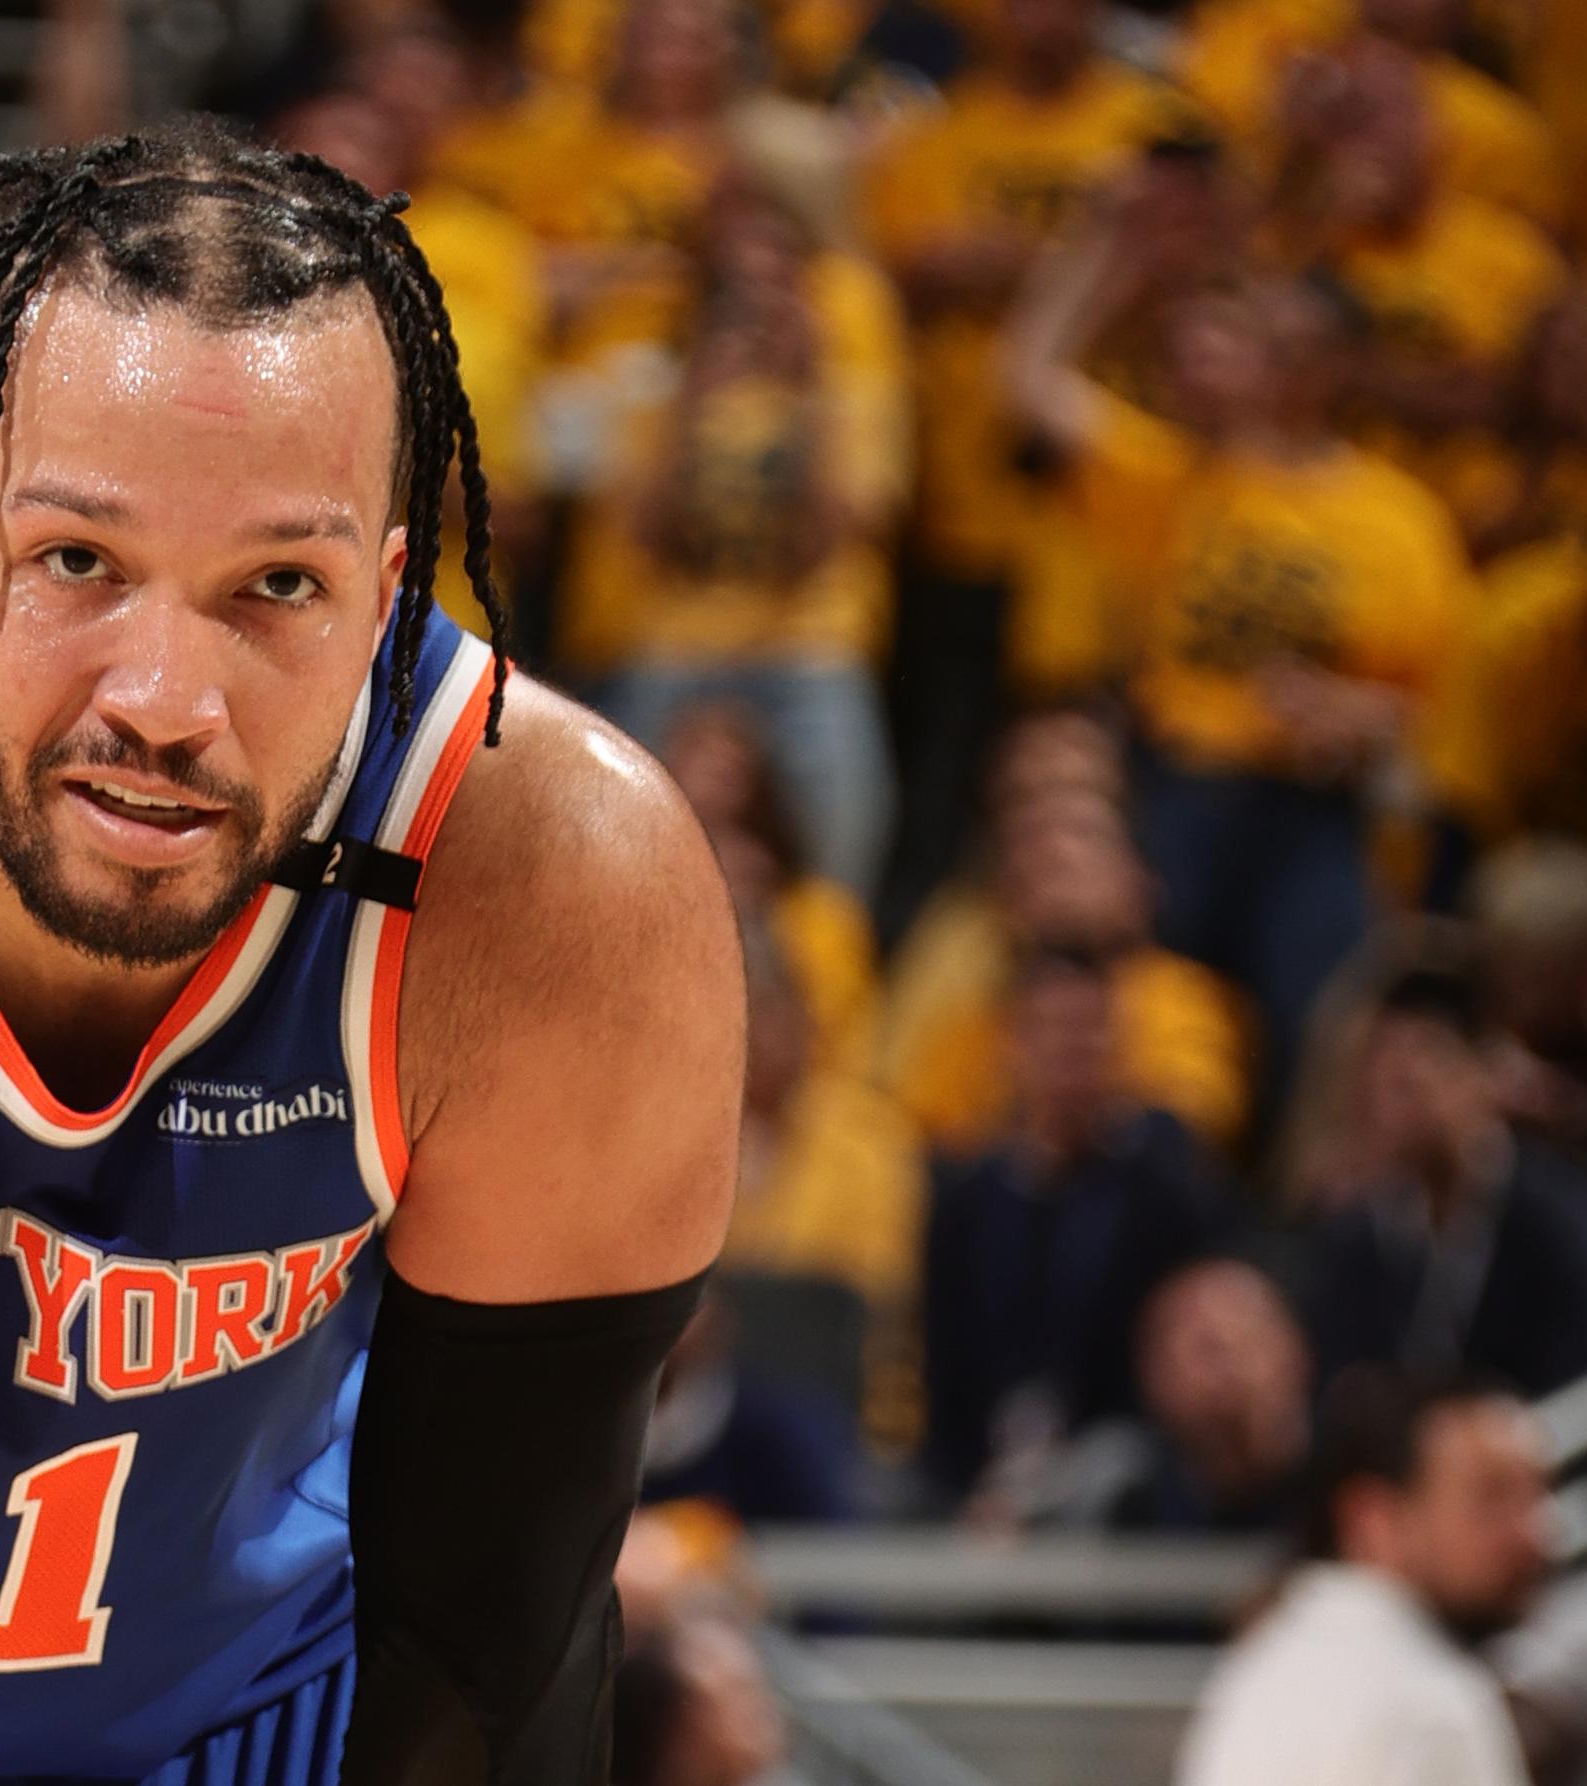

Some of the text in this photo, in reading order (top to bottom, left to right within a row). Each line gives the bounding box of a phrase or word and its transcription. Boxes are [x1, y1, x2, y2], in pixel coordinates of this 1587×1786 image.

[157, 1084, 348, 1137] abu dhabi
[4, 1207, 376, 1405] YORK
